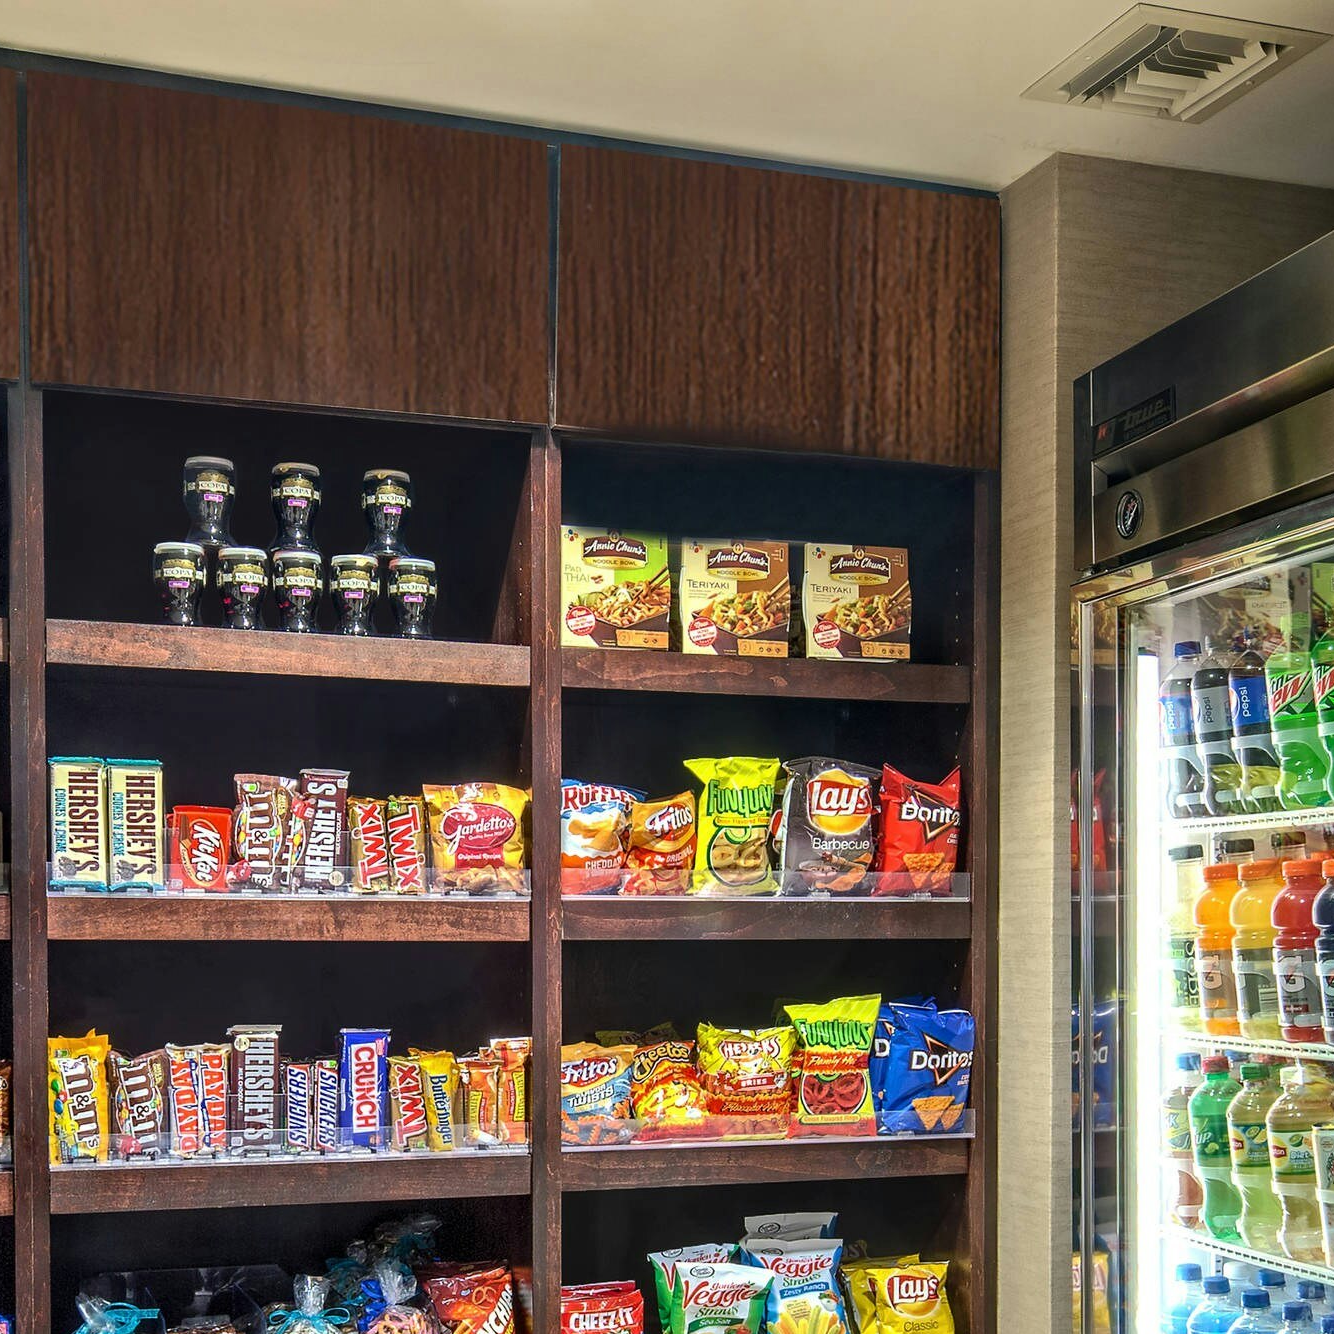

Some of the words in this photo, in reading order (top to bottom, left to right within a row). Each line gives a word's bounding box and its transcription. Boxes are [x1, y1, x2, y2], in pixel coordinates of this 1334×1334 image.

[686, 579, 730, 589] TERIYAKI
[810, 584, 852, 594] TERIYAKI
[1239, 686, 1252, 717] pepsi
[68, 771, 100, 877] HERSHEY'S
[125, 775, 156, 874] HERSHEY'S
[358, 804, 388, 888] TWIX
[388, 805, 423, 892] TWIX
[442, 806, 515, 855] Gardetto's
[646, 805, 693, 836] Fritos
[812, 838, 870, 850] Barbecue
[171, 1059, 198, 1152] PAYDAY
[202, 1053, 227, 1151] PAYDAY
[354, 1047, 377, 1130] CRUNCH
[396, 1064, 427, 1145] TWIX
[561, 1057, 618, 1085] Fritos
[288, 1069, 308, 1147] SNICKERS
[319, 1071, 337, 1149] SNICKERS
[430, 1075, 452, 1144] Butterfinger
[683, 1281, 759, 1309] Veggie
[760, 1256, 832, 1278] Veggie
[904, 1320, 938, 1333] Classic
